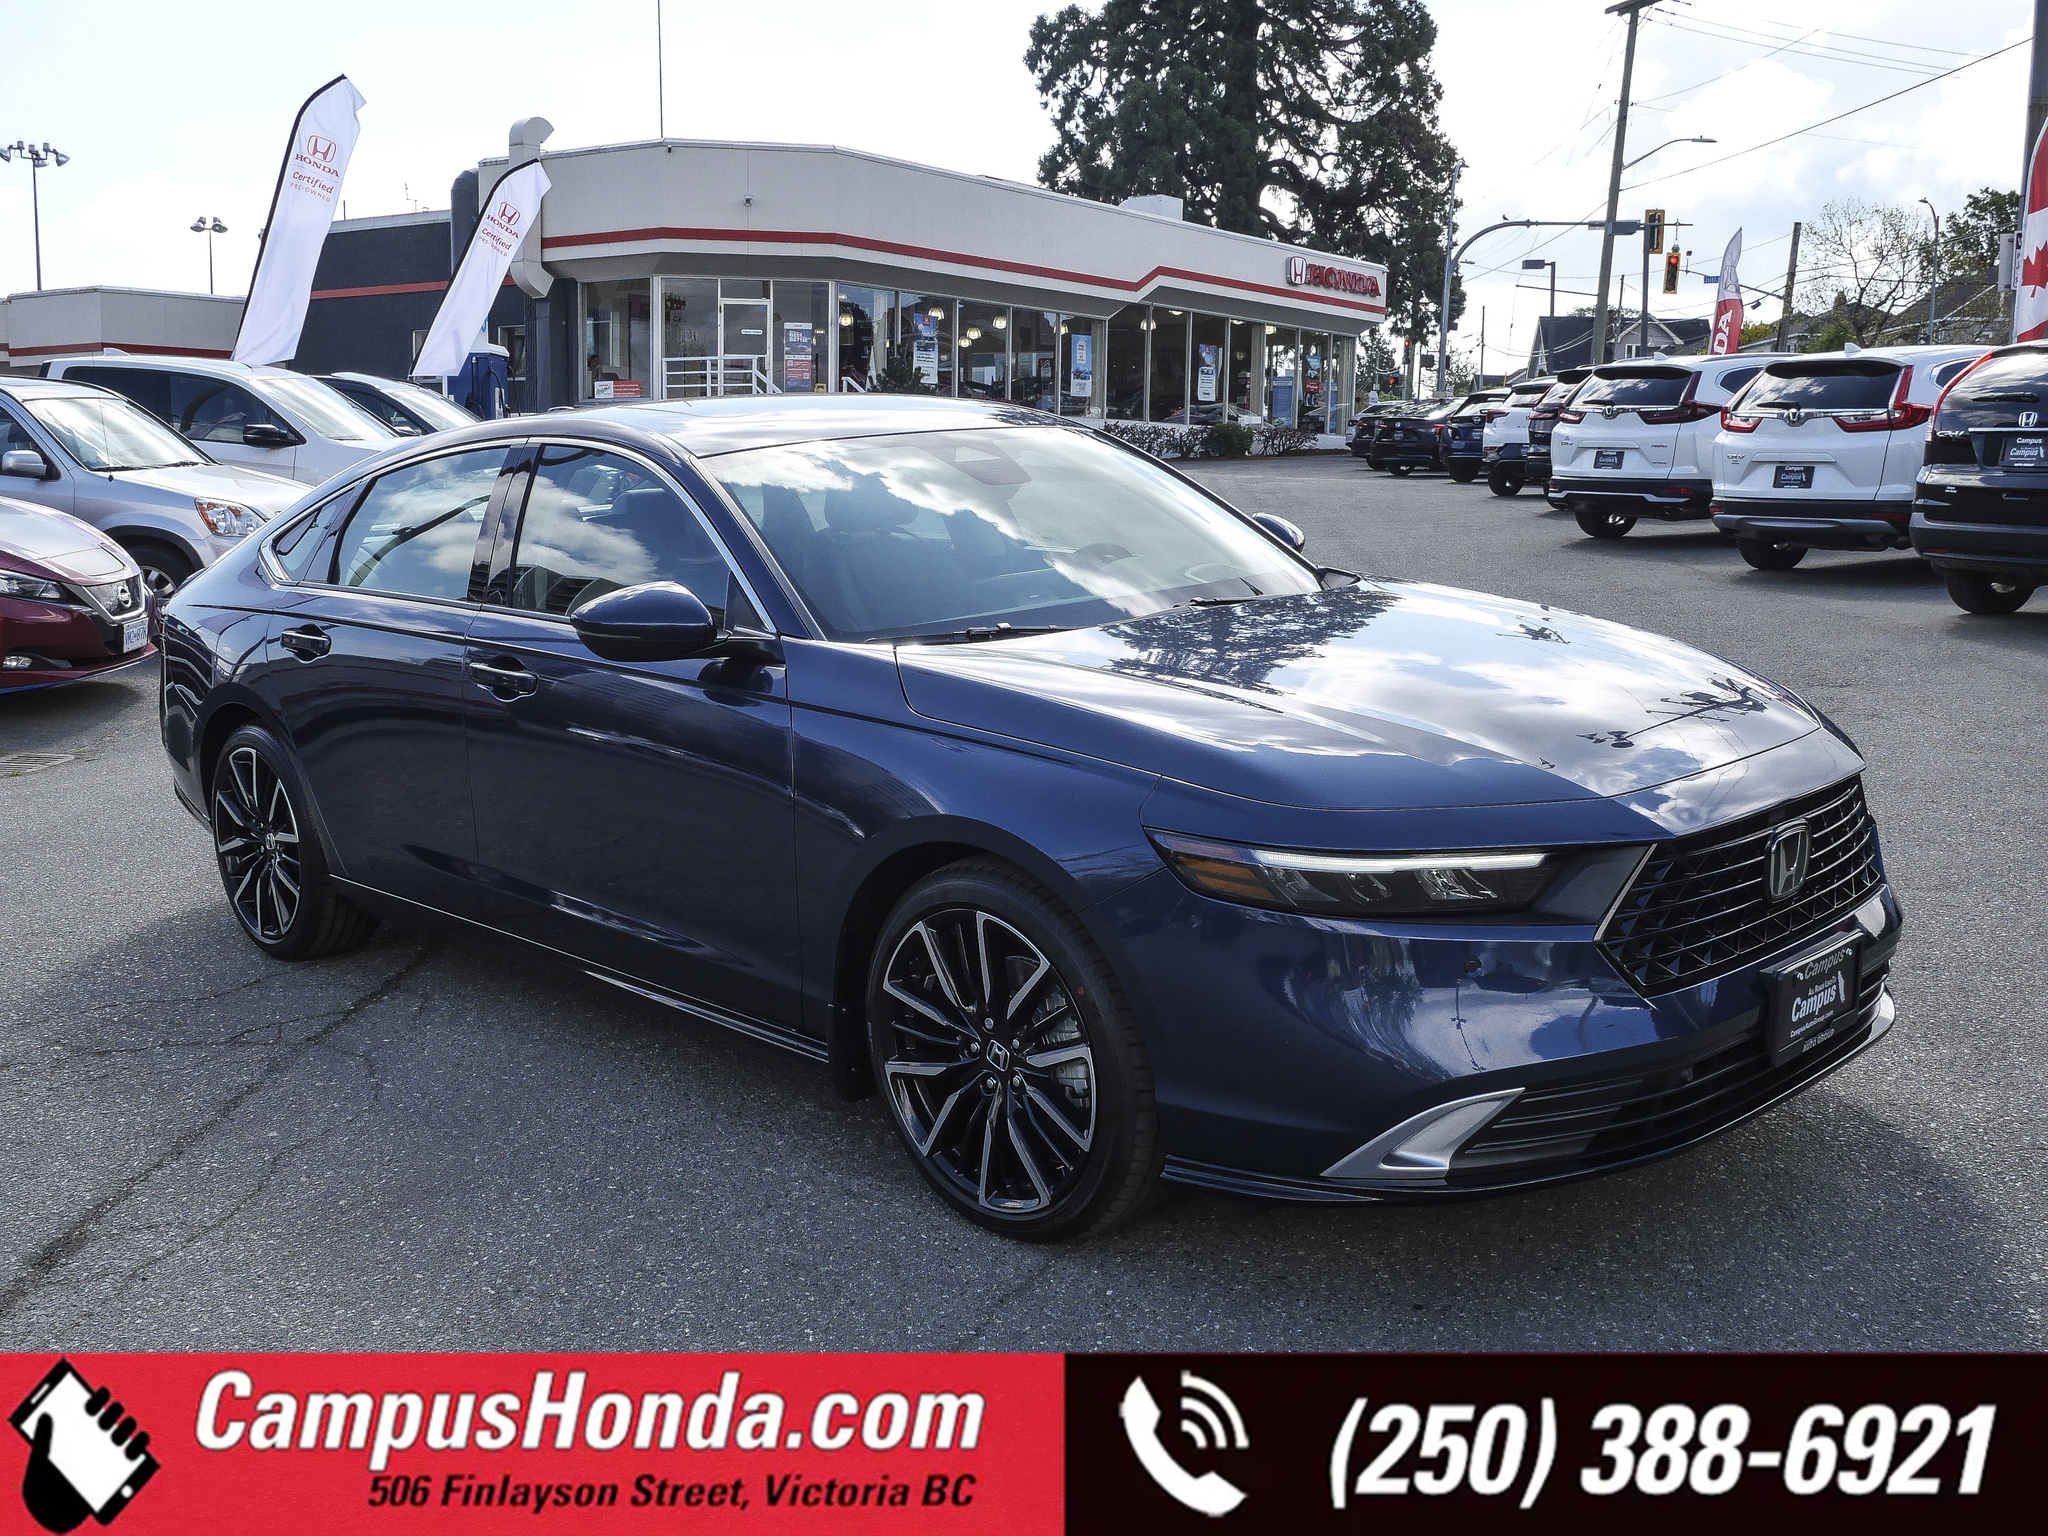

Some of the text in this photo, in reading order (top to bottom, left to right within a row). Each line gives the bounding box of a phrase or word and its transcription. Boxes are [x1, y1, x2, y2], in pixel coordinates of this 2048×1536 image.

[295, 153, 340, 178] HONDA
[290, 182, 331, 202] PRE-OWNED
[292, 171, 335, 194] Certified
[481, 227, 512, 250] Certified
[486, 214, 519, 239] HONDA
[1308, 263, 1382, 297] HONDA
[2010, 447, 2039, 457] Campus
[2016, 437, 2043, 445] Campus
[1805, 950, 1844, 980] Campus
[1791, 984, 1837, 1022] Campus
